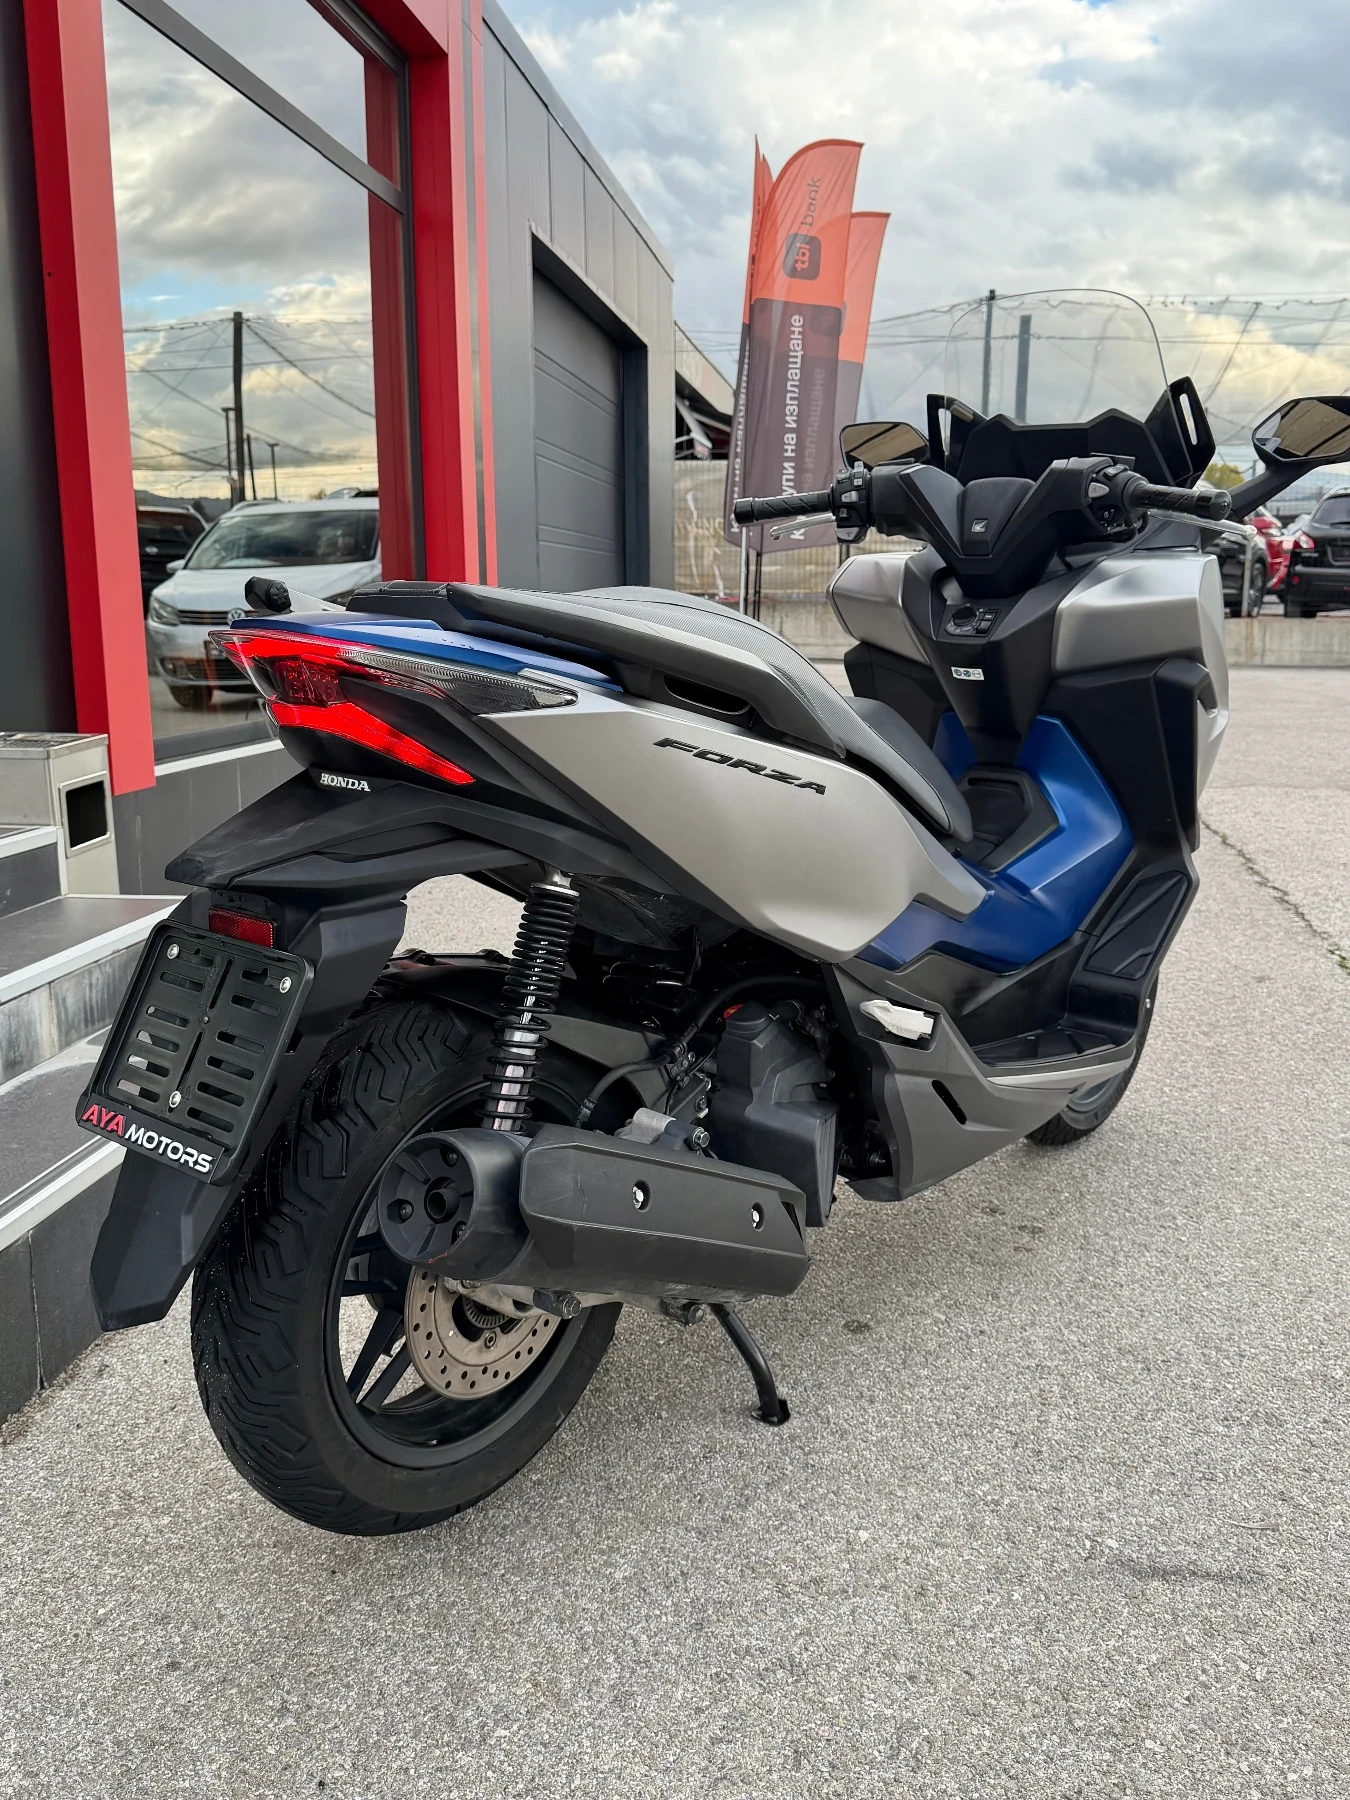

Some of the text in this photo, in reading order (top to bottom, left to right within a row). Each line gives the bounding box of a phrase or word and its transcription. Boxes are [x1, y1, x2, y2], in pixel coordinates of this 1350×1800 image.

[795, 178, 821, 271] tbi bank
[784, 314, 804, 428] изплащане
[783, 433, 797, 457] на
[781, 461, 798, 497] упи
[320, 773, 371, 792] HONDA
[653, 737, 826, 795] FORZA
[82, 1103, 213, 1174] AYA MOTORS
